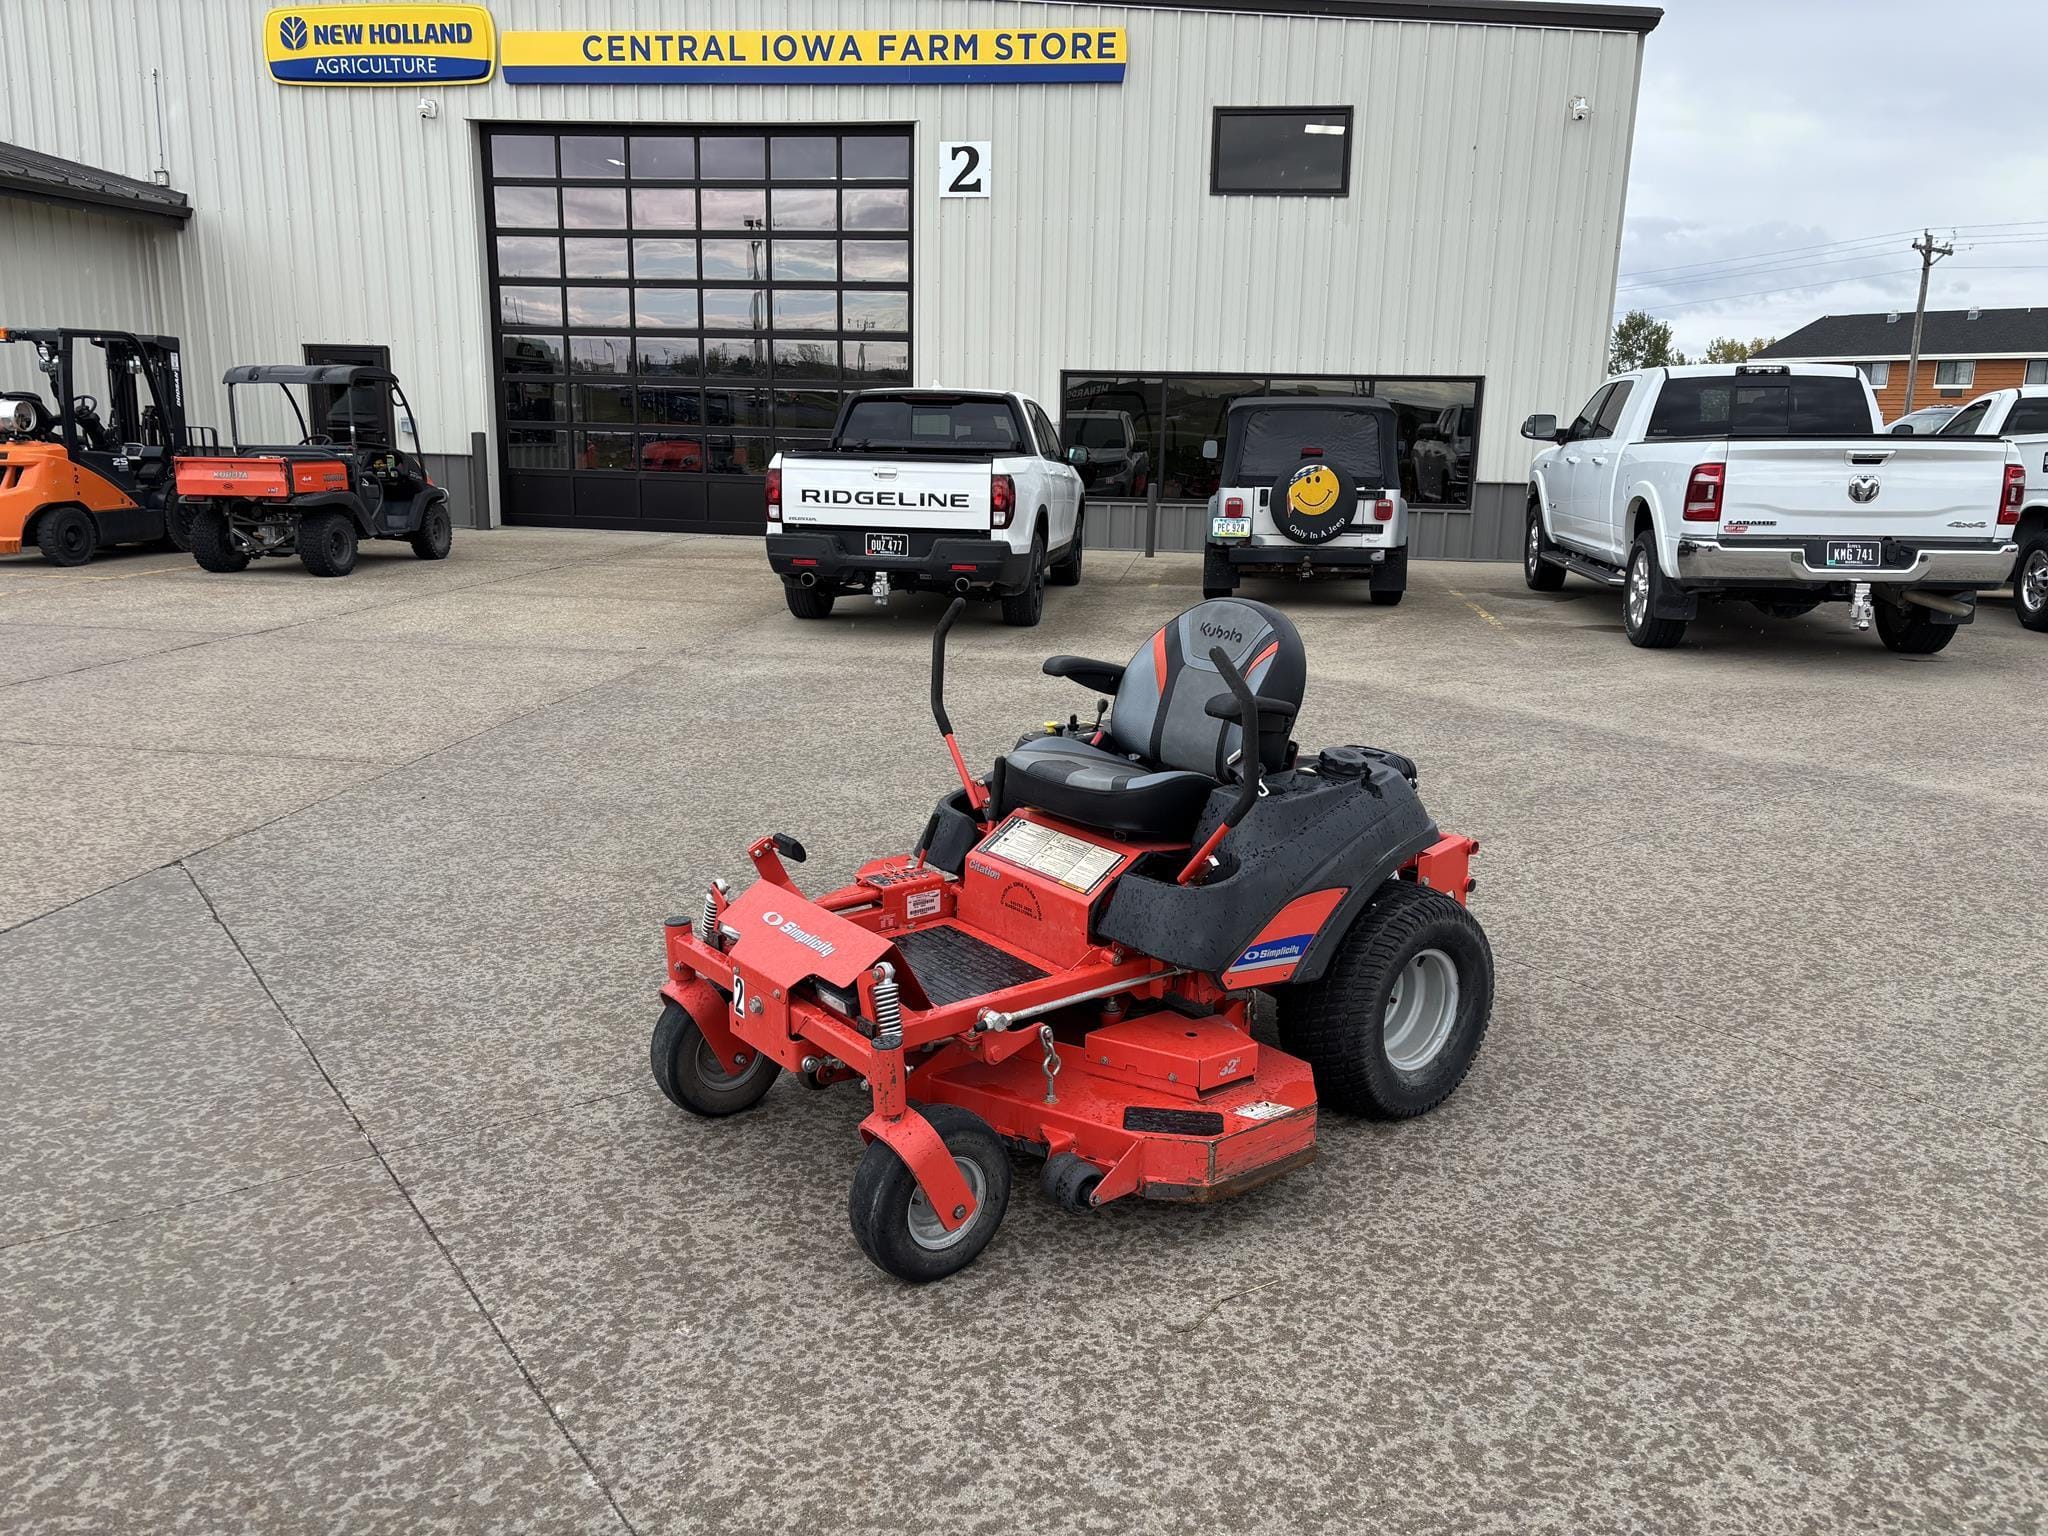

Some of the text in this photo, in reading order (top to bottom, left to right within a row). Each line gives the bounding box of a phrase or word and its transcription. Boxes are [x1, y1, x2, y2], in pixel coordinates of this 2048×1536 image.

[314, 22, 473, 45] NEW HOLLAND
[582, 32, 1117, 62] CENTRAL IOWA FARM STORE
[314, 57, 438, 75] AGRICULTURE
[948, 145, 982, 193] 2
[112, 457, 129, 466] 25
[801, 488, 970, 509] RIDGELINE
[1217, 523, 1230, 532] PEC
[1289, 517, 1345, 539] Only In A Jeep
[887, 540, 902, 551] 477
[1834, 548, 1873, 561] KMG 741
[1200, 622, 1243, 643] Kubota
[968, 859, 1001, 880] Citation
[779, 921, 838, 958] Simplicity
[1259, 944, 1300, 958] Simplicity
[734, 977, 744, 1016] 2
